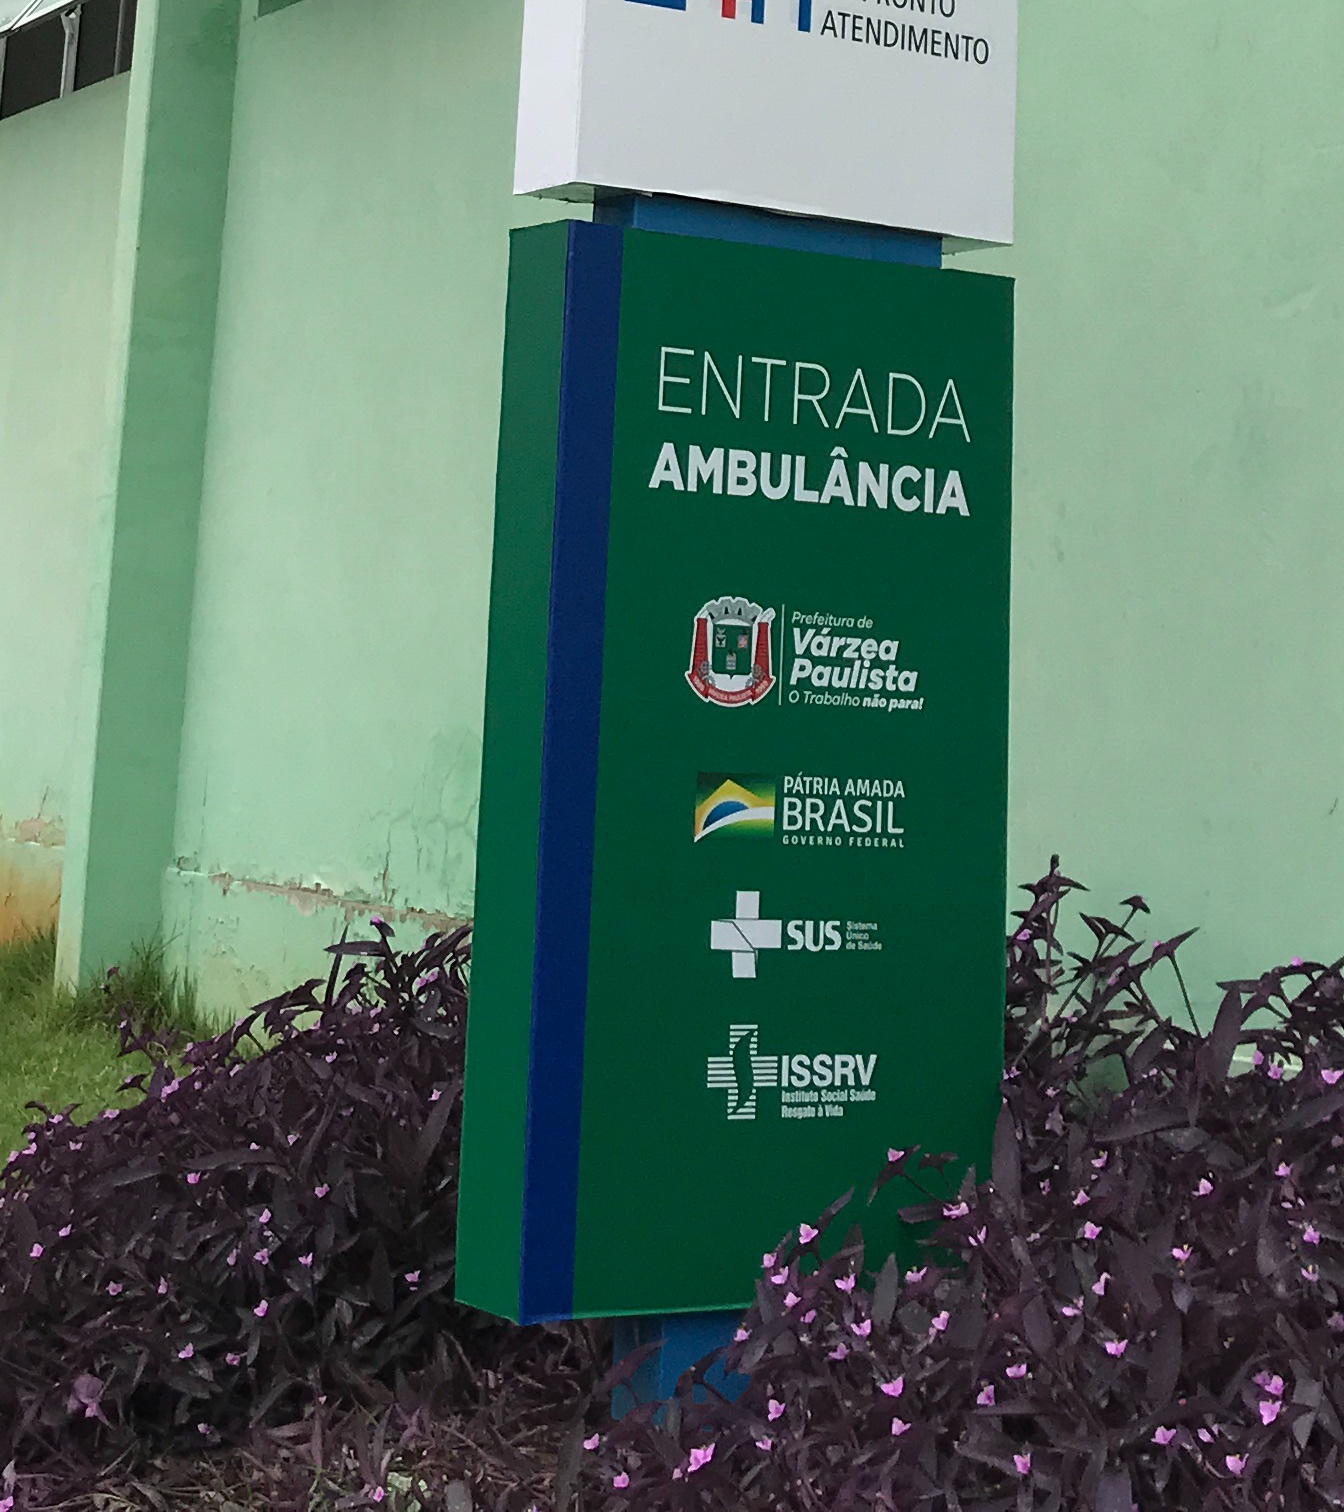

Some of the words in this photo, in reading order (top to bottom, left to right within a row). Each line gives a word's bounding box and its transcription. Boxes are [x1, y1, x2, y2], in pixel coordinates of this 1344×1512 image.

[819, 9, 990, 65] ATENDIMENTO
[657, 345, 971, 443] ENTRADA
[648, 441, 971, 517] AMBULÂNCIA
[791, 610, 855, 628] Prefeitura
[857, 615, 873, 629] de
[792, 627, 900, 661] Várzea
[789, 657, 919, 693] Paulista
[788, 689, 800, 704] O
[803, 690, 861, 707] Trabalho
[862, 692, 887, 708] não
[887, 696, 925, 713] para!
[783, 770, 841, 796] PÁTRIA
[843, 778, 906, 799] AMADA
[782, 796, 905, 834] BRASIL
[782, 834, 842, 847] GOVERNO
[848, 836, 905, 848] FEDERAL
[786, 919, 842, 953] SUS
[781, 1053, 878, 1088] ISSRV
[781, 1089, 819, 1103] Instituto
[820, 1088, 848, 1103] Social
[849, 1088, 877, 1102] Saúde
[824, 1103, 844, 1118] Vida
